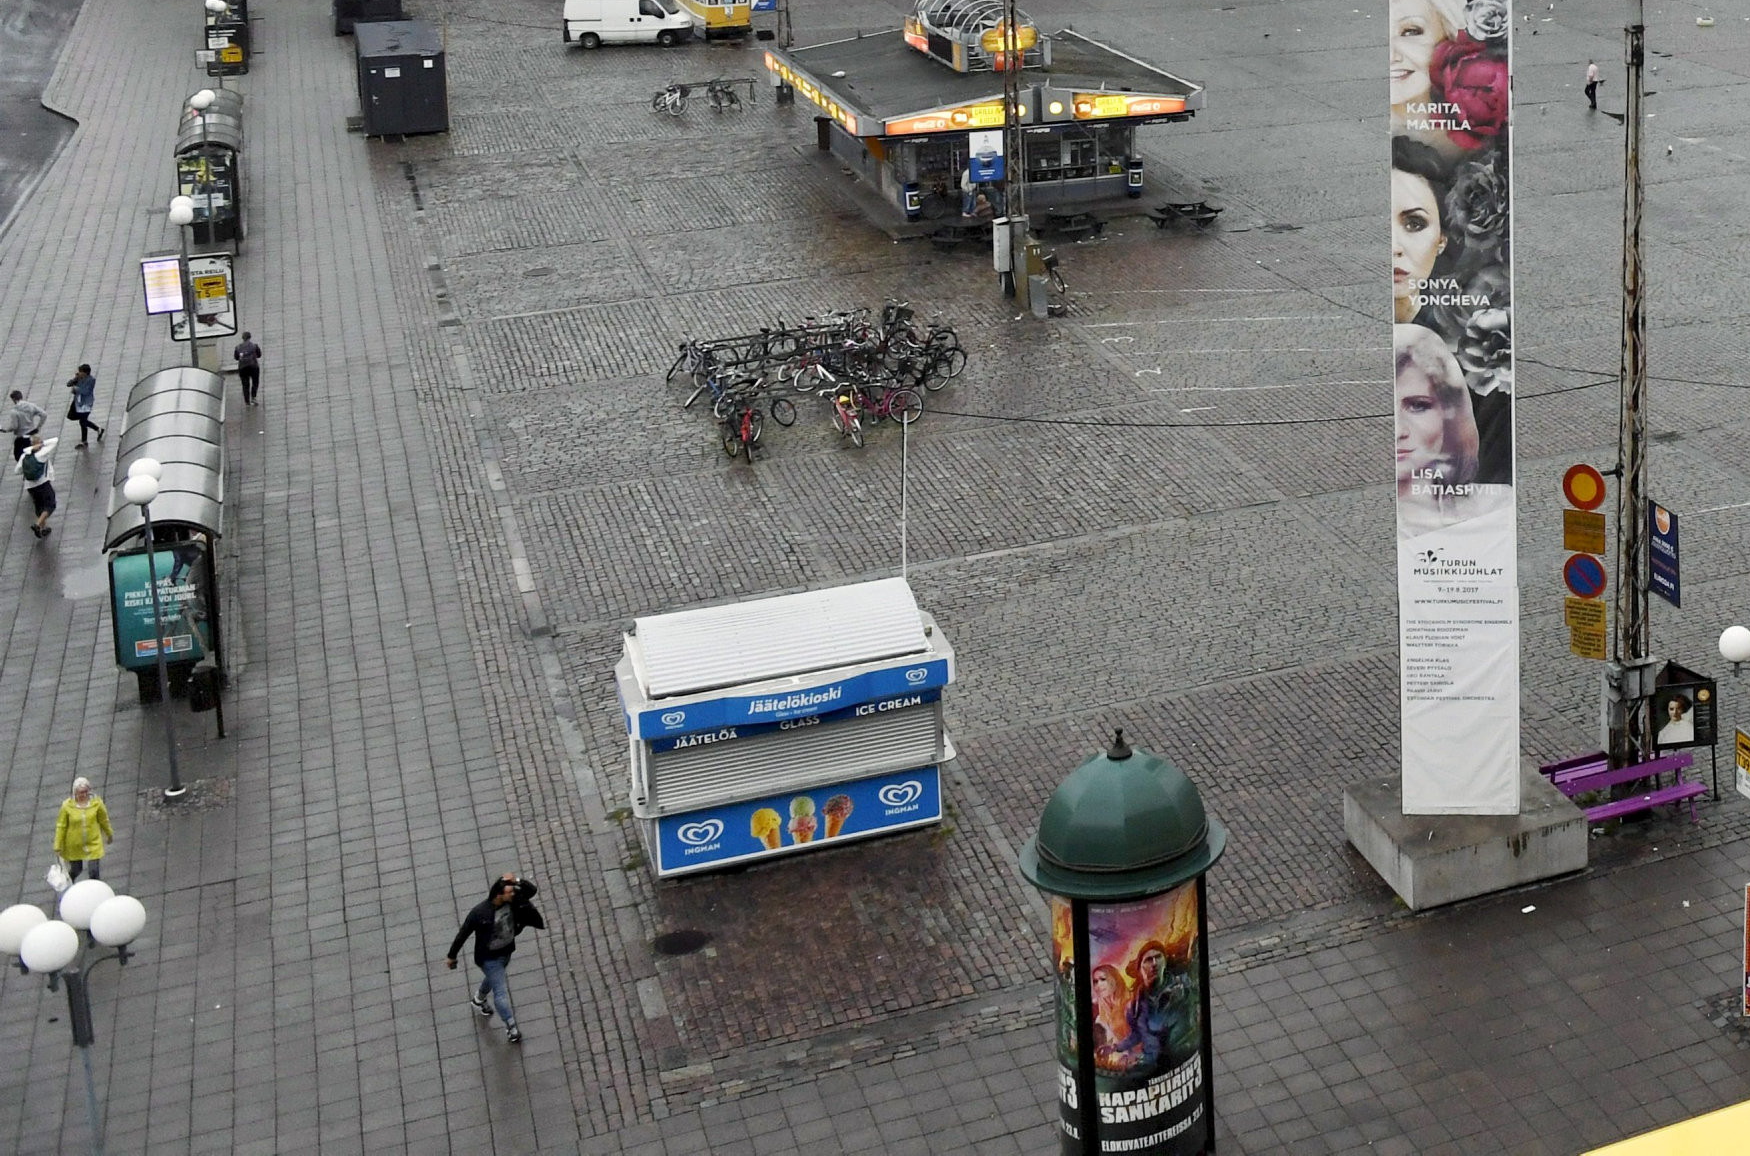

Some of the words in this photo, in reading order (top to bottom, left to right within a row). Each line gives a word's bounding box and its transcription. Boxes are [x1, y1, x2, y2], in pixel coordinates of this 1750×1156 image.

[1406, 102, 1461, 114] KARITA
[1406, 119, 1471, 131] MATTILA
[1408, 278, 1459, 290] SONYA
[1409, 294, 1491, 306] YONCHEVA
[1411, 468, 1444, 479] LISA
[1411, 484, 1502, 495] BATIASHVILI
[1440, 559, 1477, 567] TURUN
[1413, 568, 1504, 576] MUSIIKKIJUHLAT
[747, 685, 842, 715] Jäätelökioski
[855, 703, 876, 717] ICE
[878, 695, 922, 712] CREAM
[780, 715, 821, 731] GLASS
[673, 728, 738, 751] JÄÄTELÖÄ
[885, 803, 919, 817] INGMAN
[684, 842, 721, 856] INGMAN
[1099, 1065, 1194, 1108] NAPAPIIRIN
[1101, 1079, 1195, 1124] SANKARIT
[1101, 1119, 1192, 1153] ELOKUVATEATTEREISSA
